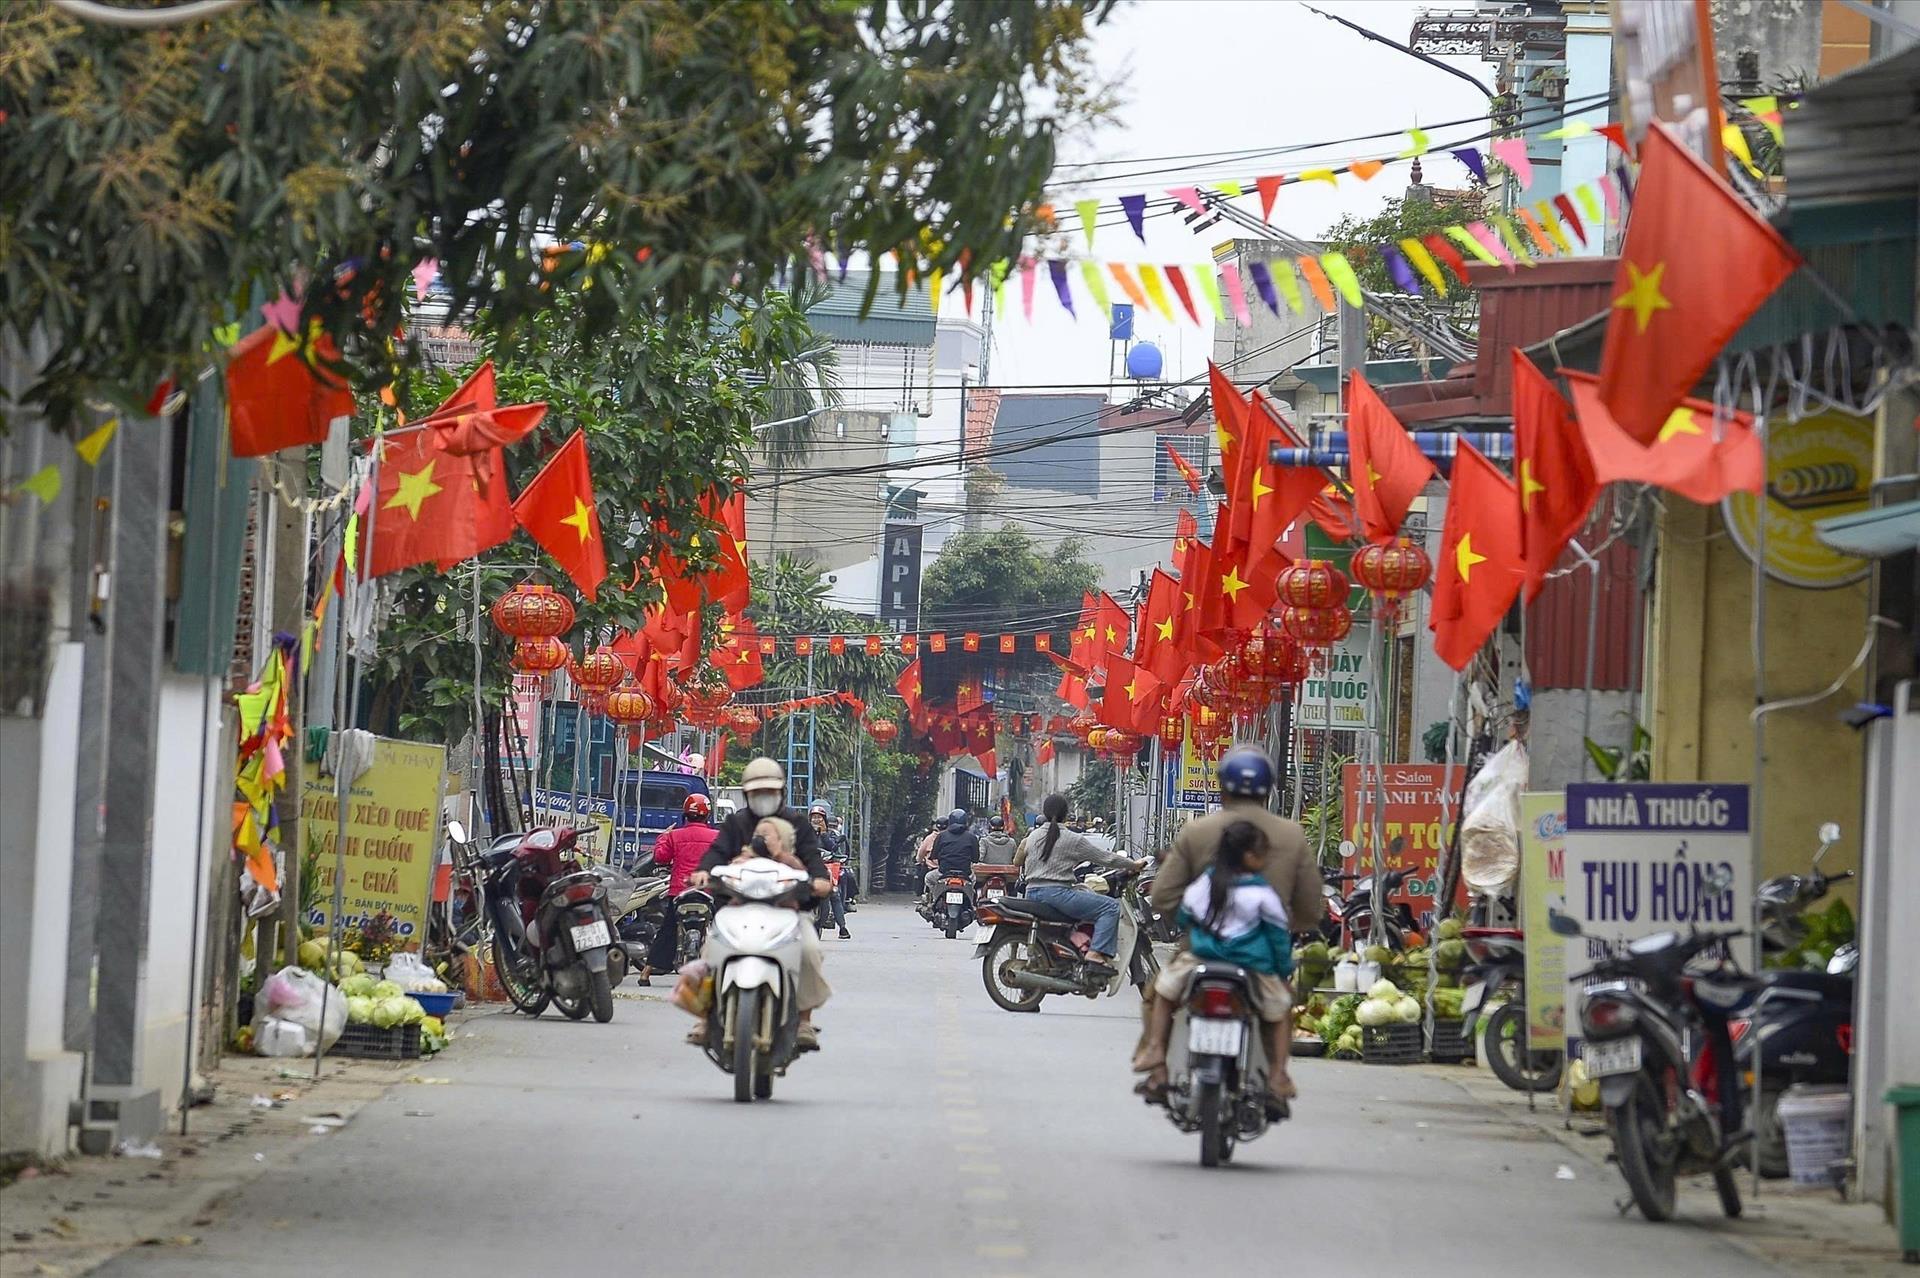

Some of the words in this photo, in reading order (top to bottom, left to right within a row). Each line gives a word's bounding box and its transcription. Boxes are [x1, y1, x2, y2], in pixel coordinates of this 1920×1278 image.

[1395, 770, 1433, 786] Salon
[395, 808, 431, 833] QUÊ
[1585, 792, 1641, 826] NHÀ
[1645, 789, 1730, 826] THUỐC
[363, 835, 415, 863] CUỐN
[1582, 861, 1639, 922] THU
